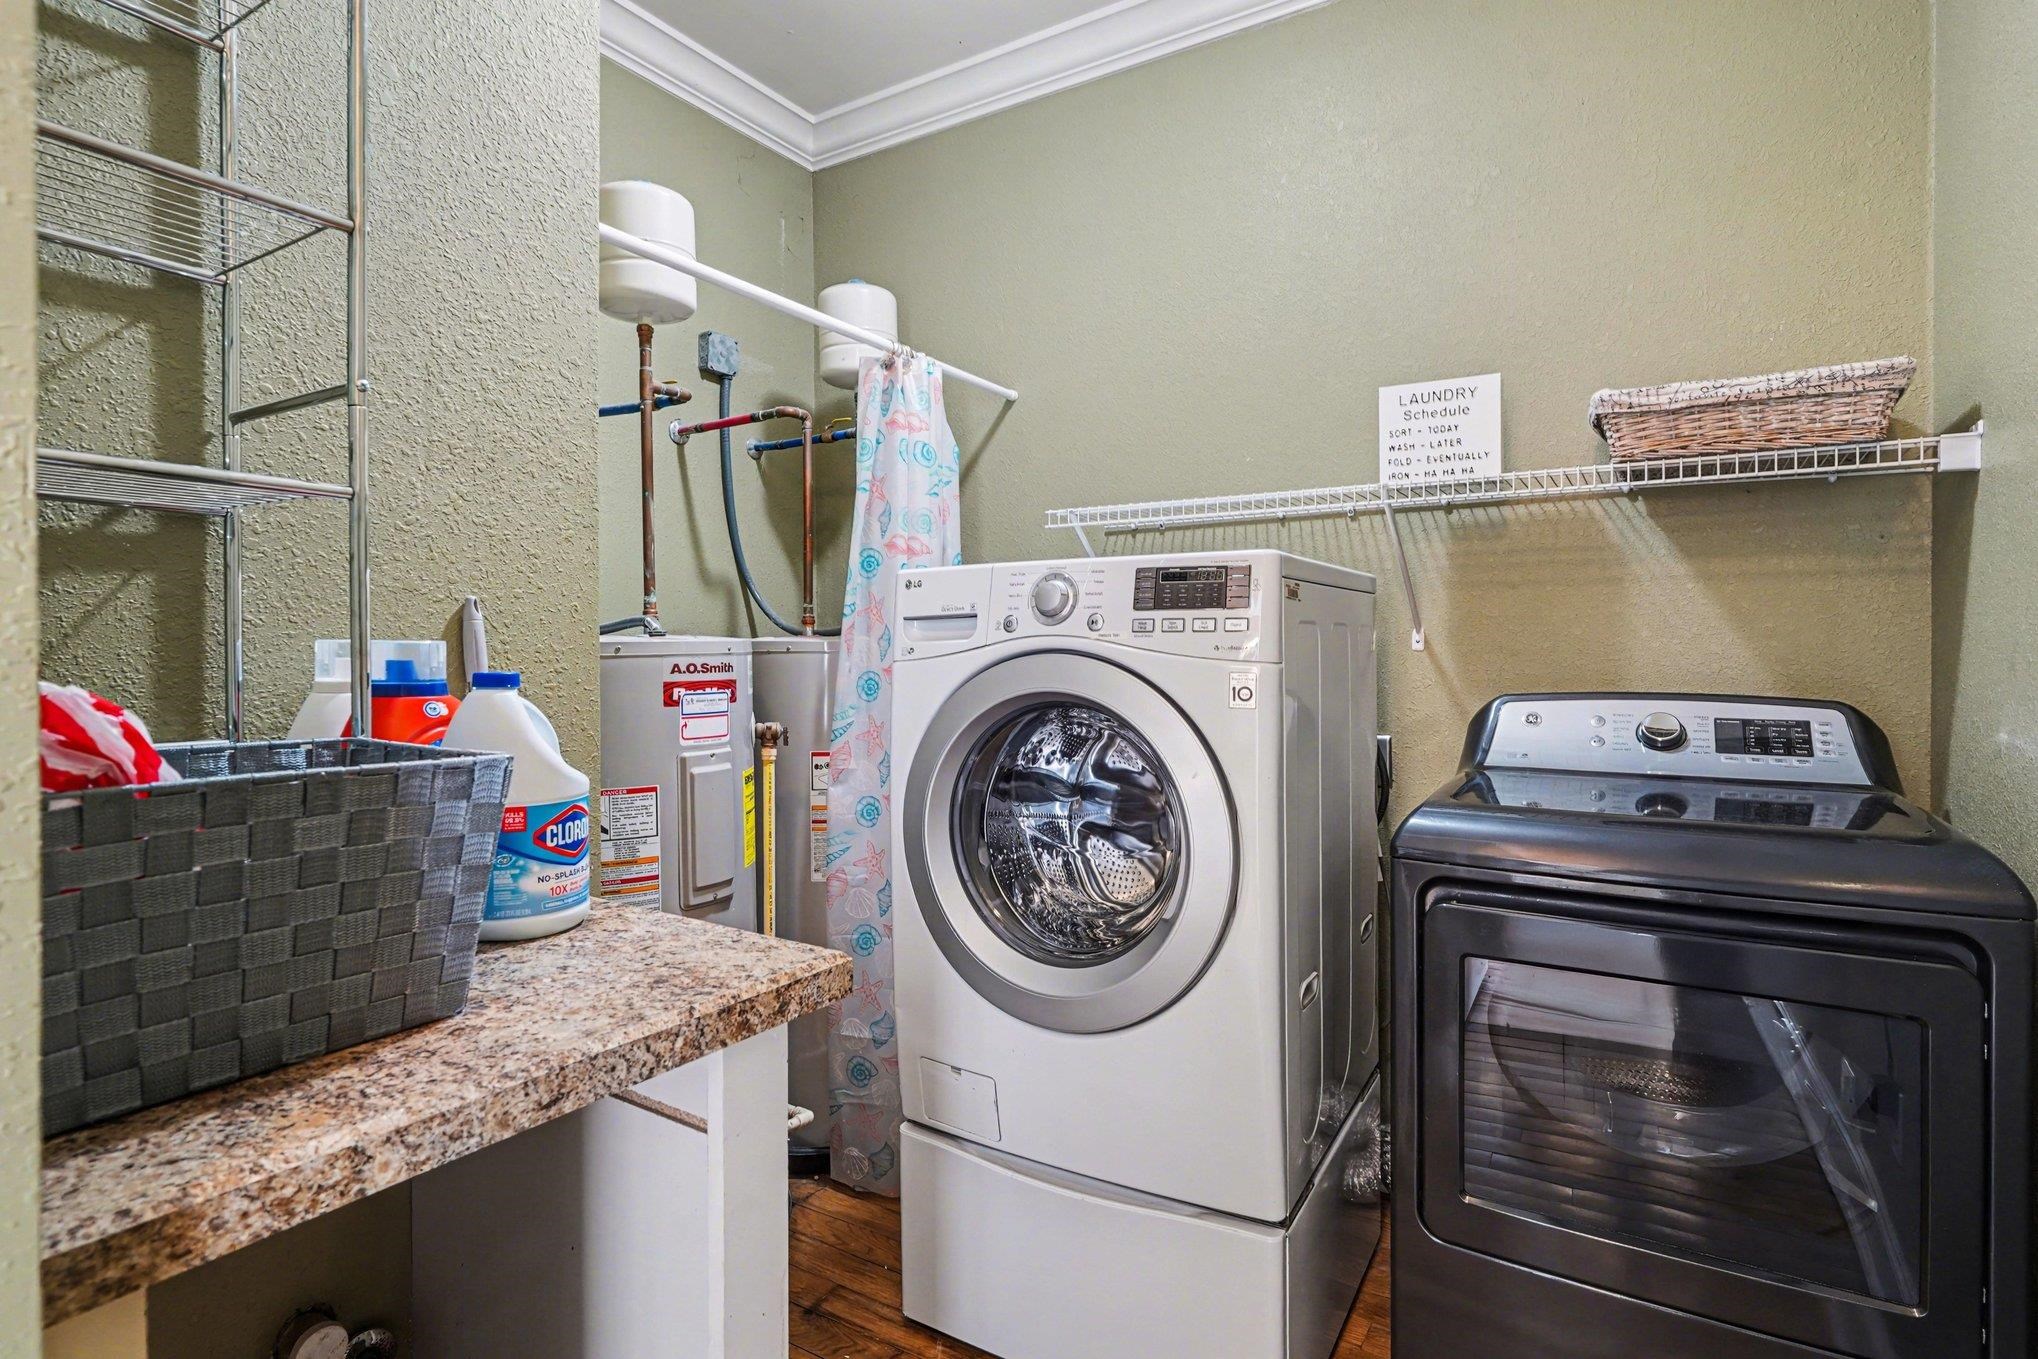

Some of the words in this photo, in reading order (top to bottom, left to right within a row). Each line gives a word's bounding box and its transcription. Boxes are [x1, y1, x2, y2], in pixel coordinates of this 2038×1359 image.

[1399, 387, 1478, 406] LAUNDRY
[1403, 405, 1470, 421] Schedule
[1389, 428, 1412, 438] SORT
[1428, 424, 1459, 434] TODAY
[1389, 442, 1415, 452] WASH
[1429, 437, 1462, 449] LATER
[1388, 457, 1412, 467] FOLD
[1426, 451, 1490, 464] EVENTUALLY
[1388, 471, 1410, 481] IRON
[1424, 470, 1437, 478] HA
[1442, 467, 1456, 476] HA
[1461, 466, 1475, 474] HA
[1232, 686, 1253, 702] 10
[545, 818, 588, 847] CLORO
[537, 868, 580, 883] NO-SPLASH
[550, 884, 568, 896] 10X
